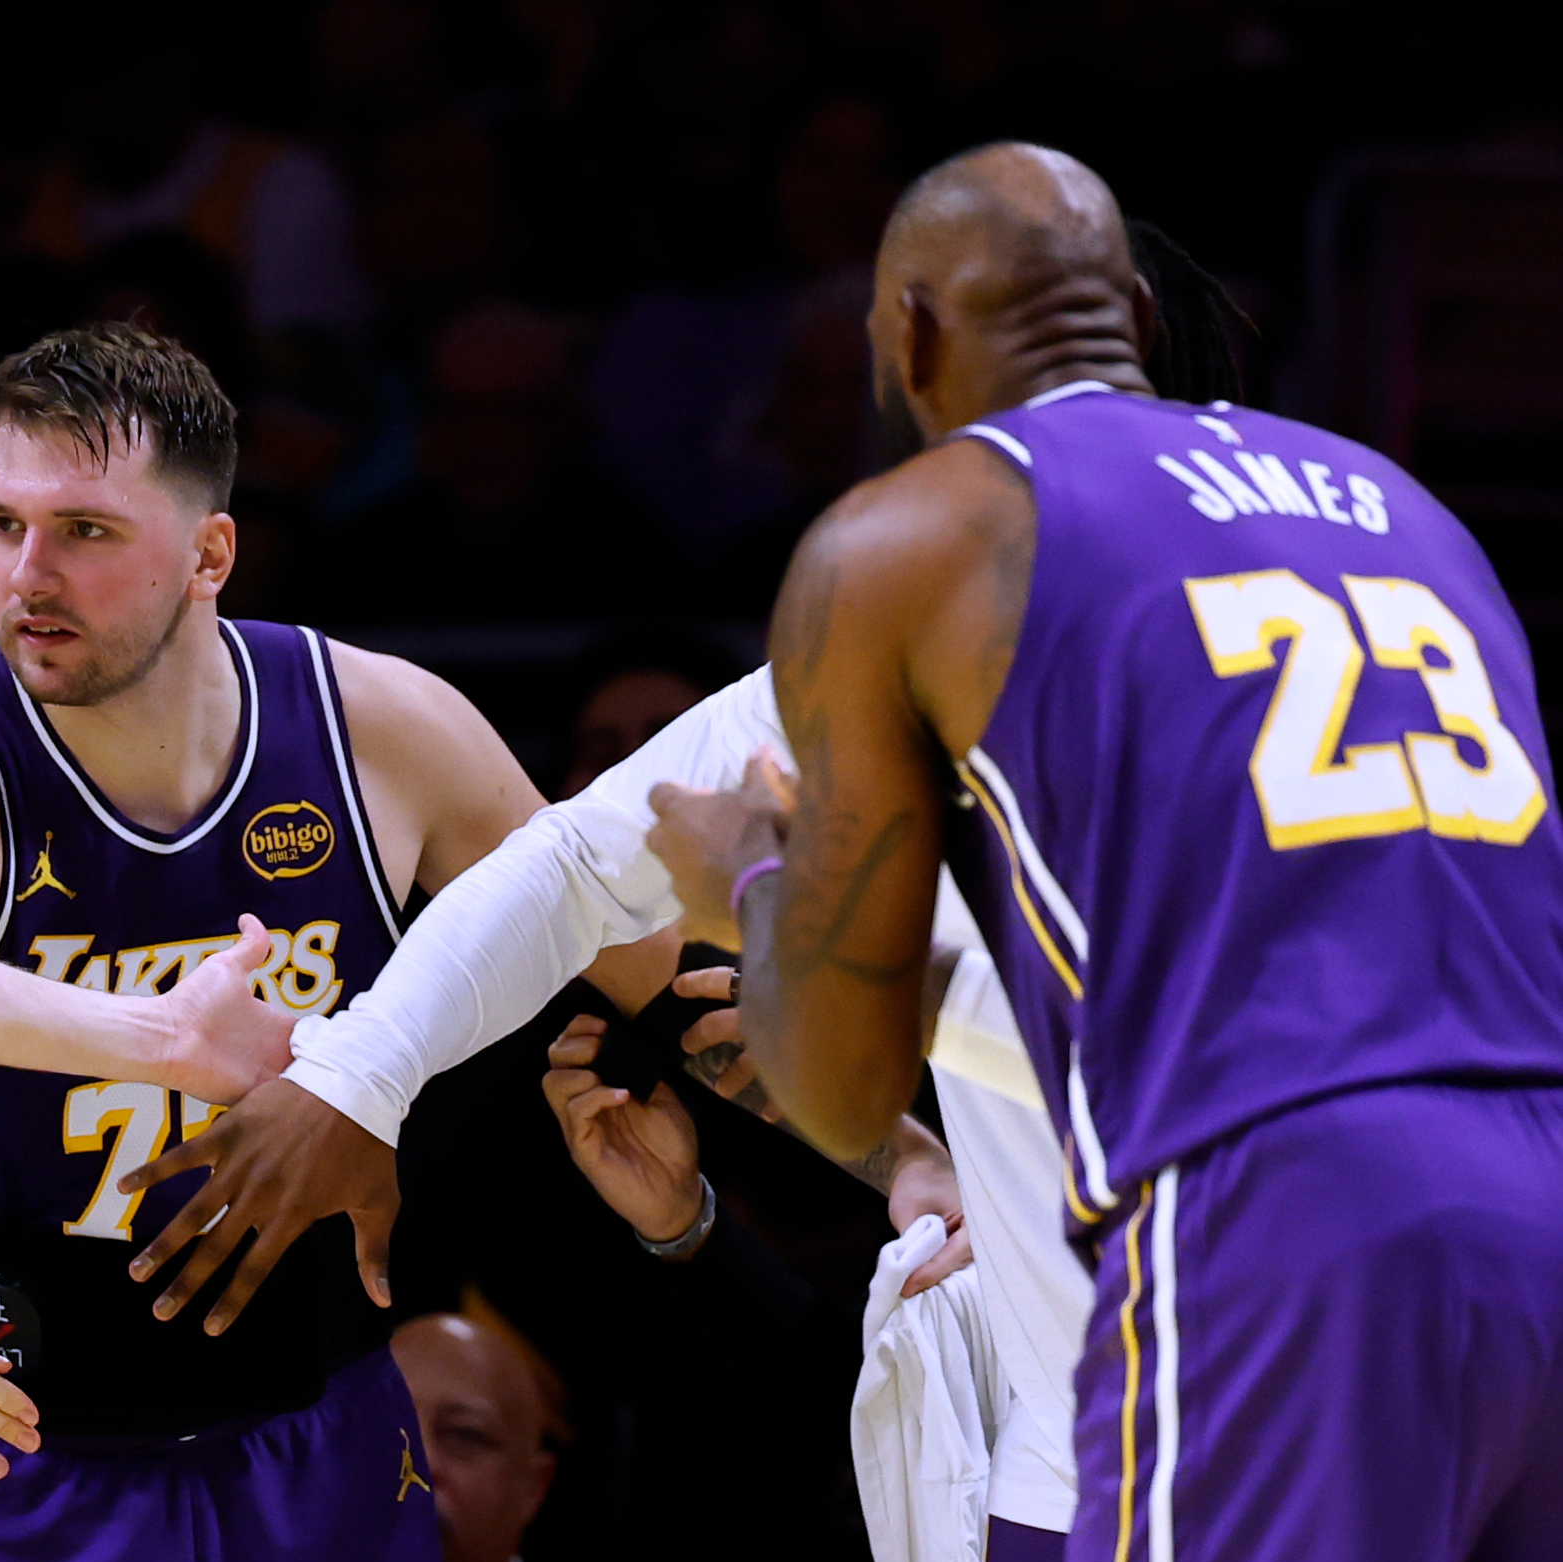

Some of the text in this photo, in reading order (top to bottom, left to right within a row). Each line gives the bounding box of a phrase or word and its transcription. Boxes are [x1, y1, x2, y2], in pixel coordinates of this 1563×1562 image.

[1155, 449, 1390, 535] JAMES
[1182, 568, 1547, 851] 23
[250, 822, 328, 853] bibigo
